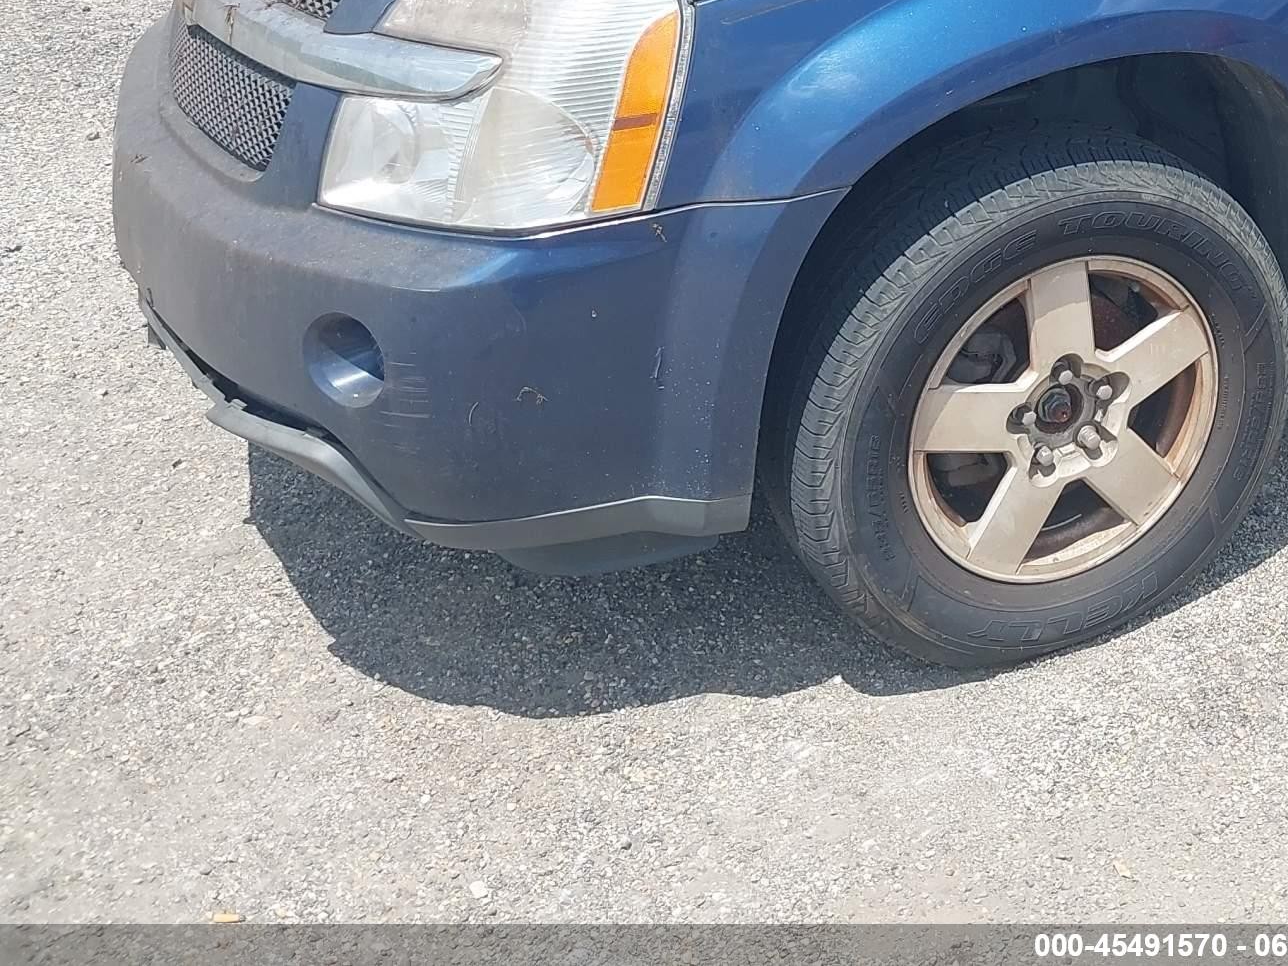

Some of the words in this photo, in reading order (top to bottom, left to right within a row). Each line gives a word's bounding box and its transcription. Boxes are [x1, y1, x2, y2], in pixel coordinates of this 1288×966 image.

[914, 229, 1037, 345] EDGE
[1058, 210, 1252, 292] TOURING
[968, 571, 1158, 642] KELLY
